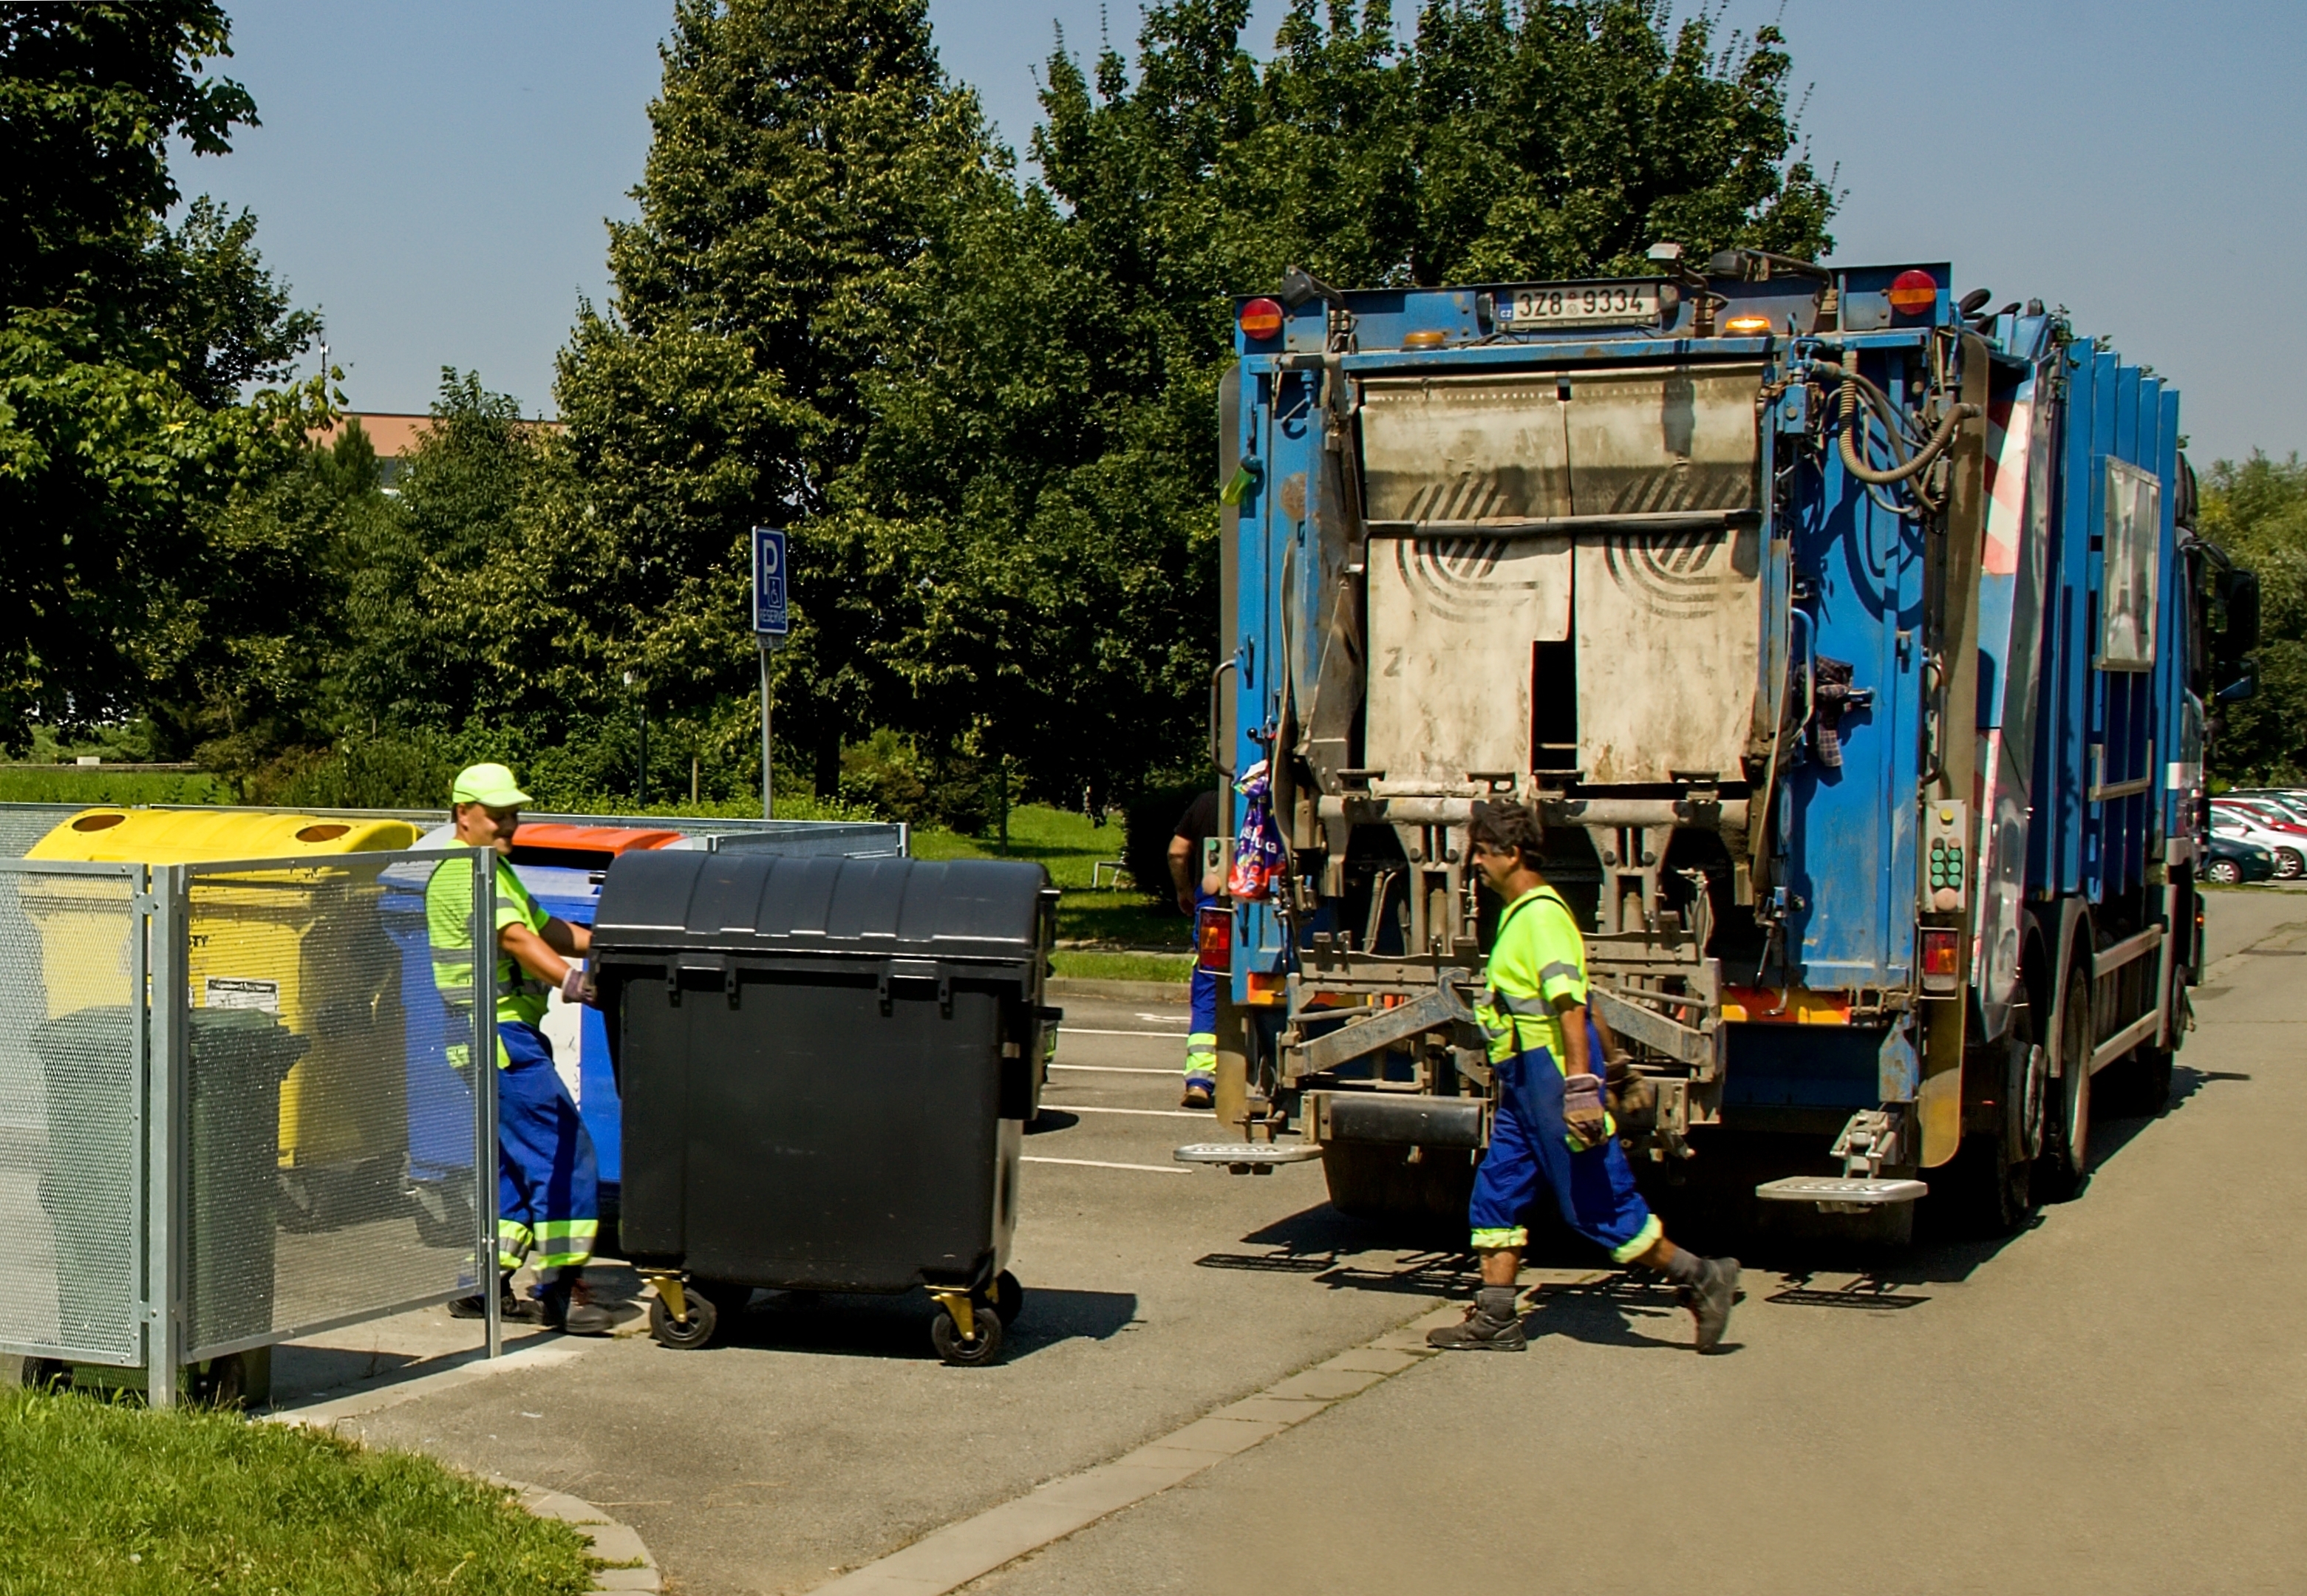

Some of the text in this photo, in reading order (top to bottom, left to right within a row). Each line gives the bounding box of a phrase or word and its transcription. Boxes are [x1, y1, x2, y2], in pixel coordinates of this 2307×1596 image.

[1500, 309, 1513, 318] CZ
[1519, 287, 1643, 317] 3Z8 9334
[763, 539, 778, 595] P
